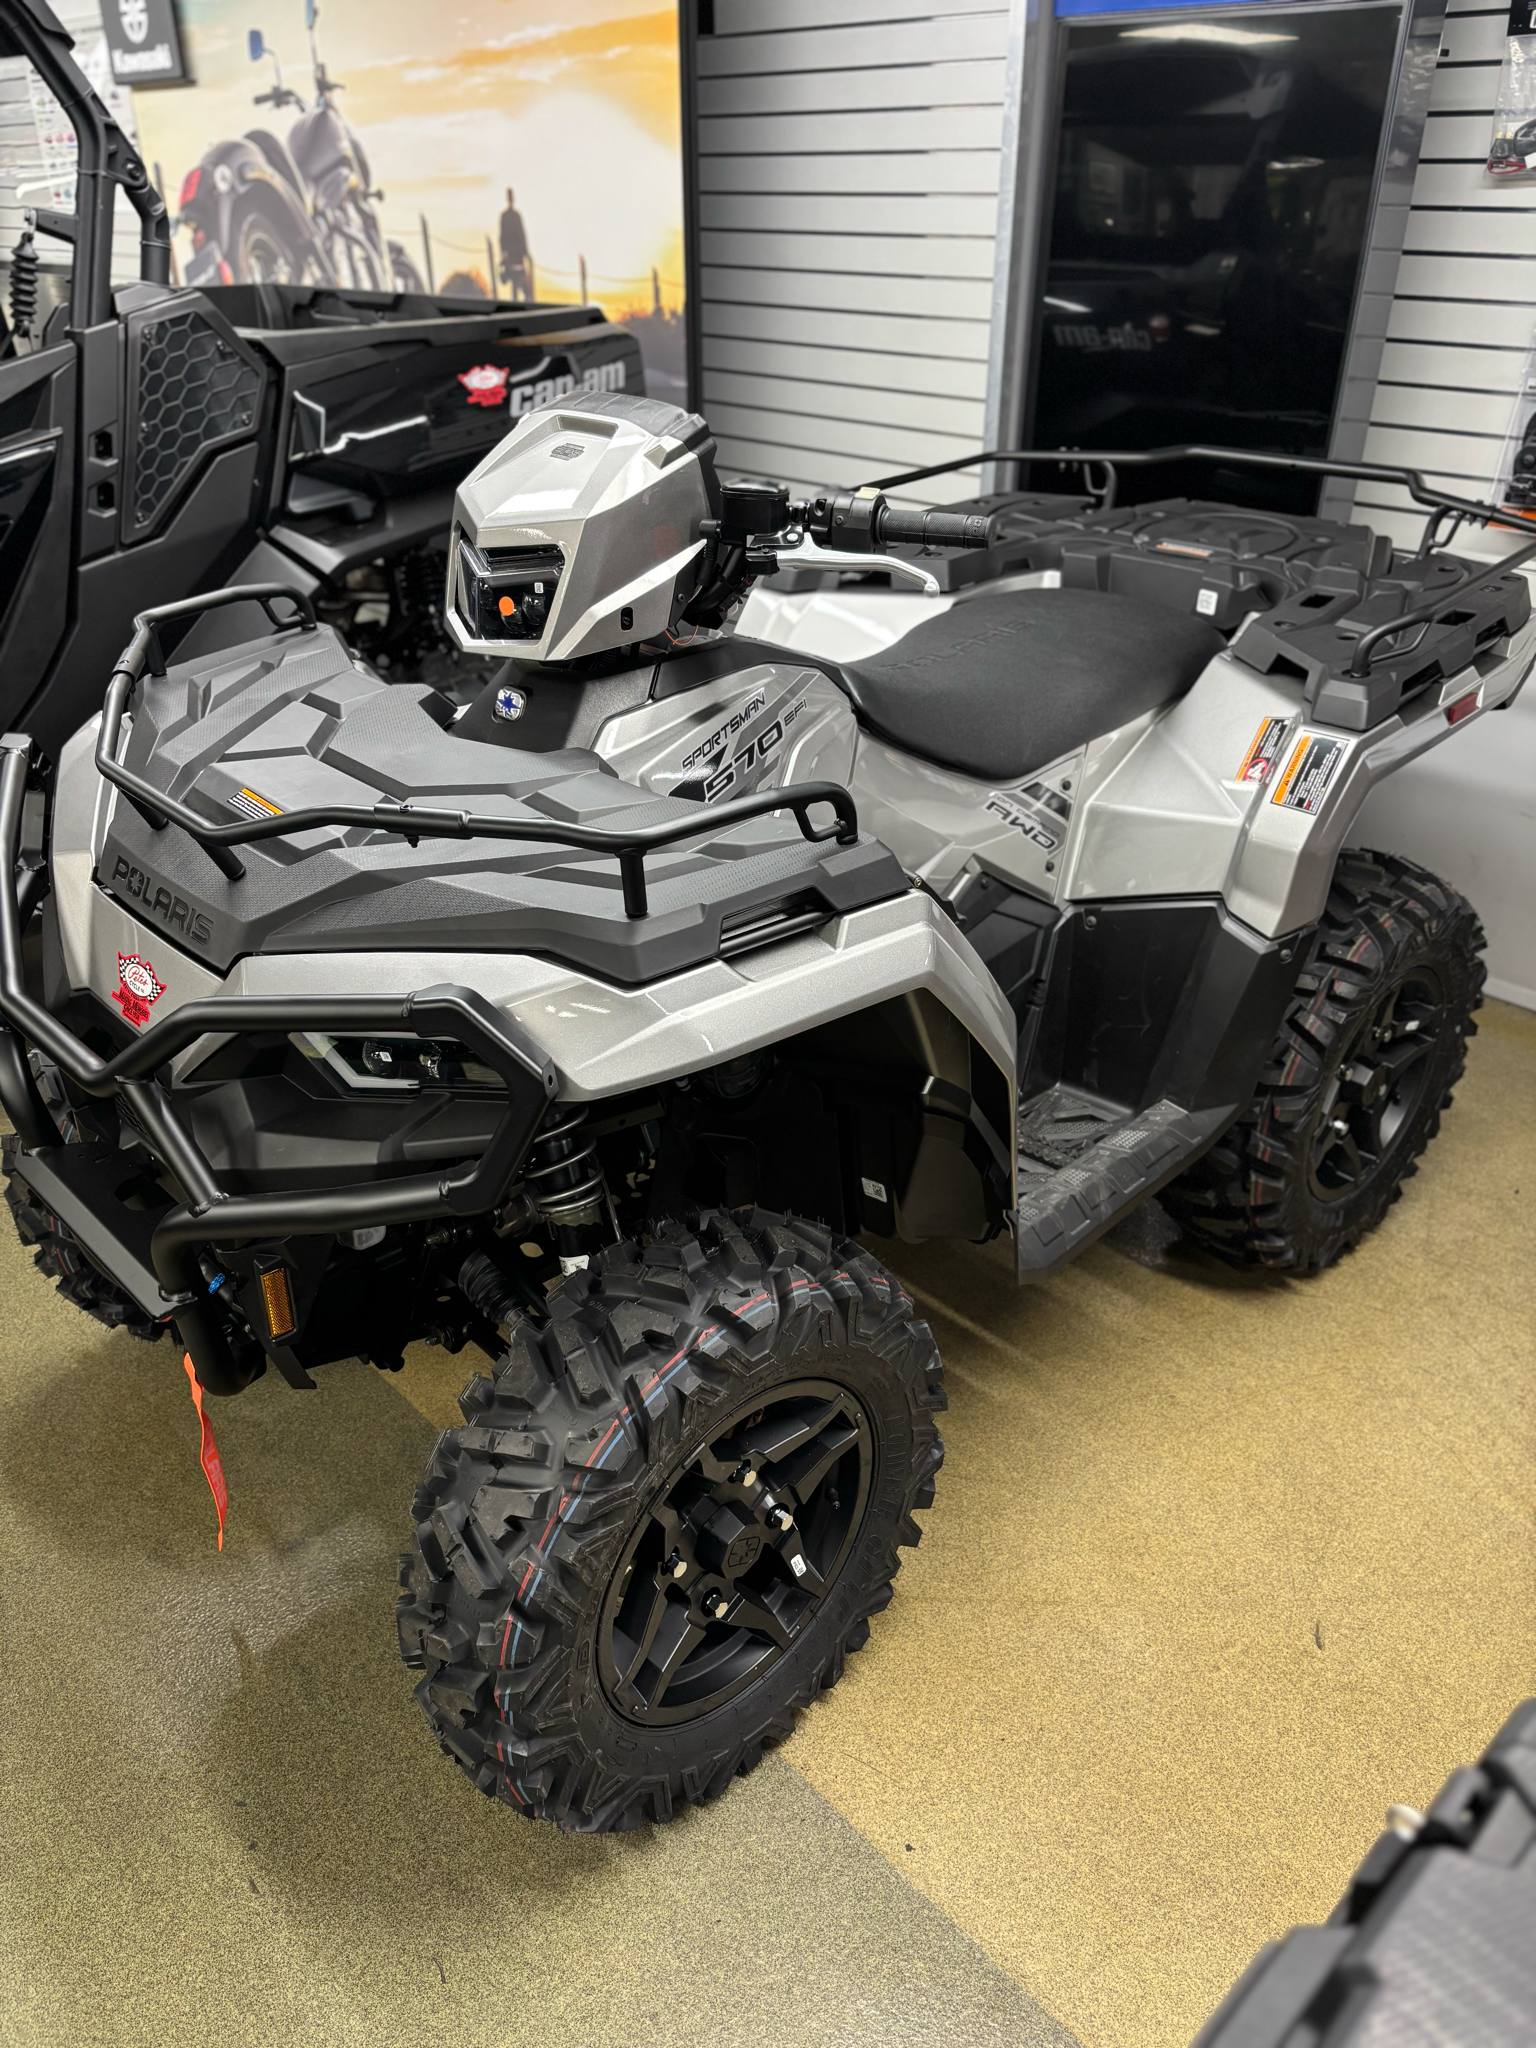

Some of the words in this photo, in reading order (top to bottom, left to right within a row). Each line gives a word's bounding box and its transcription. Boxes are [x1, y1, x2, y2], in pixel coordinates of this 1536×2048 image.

[681, 691, 766, 770] SPORTSMAN
[704, 719, 784, 803] 570
[783, 699, 808, 727] EFI
[984, 800, 1057, 850] AWD
[111, 854, 215, 946] POLARIS
